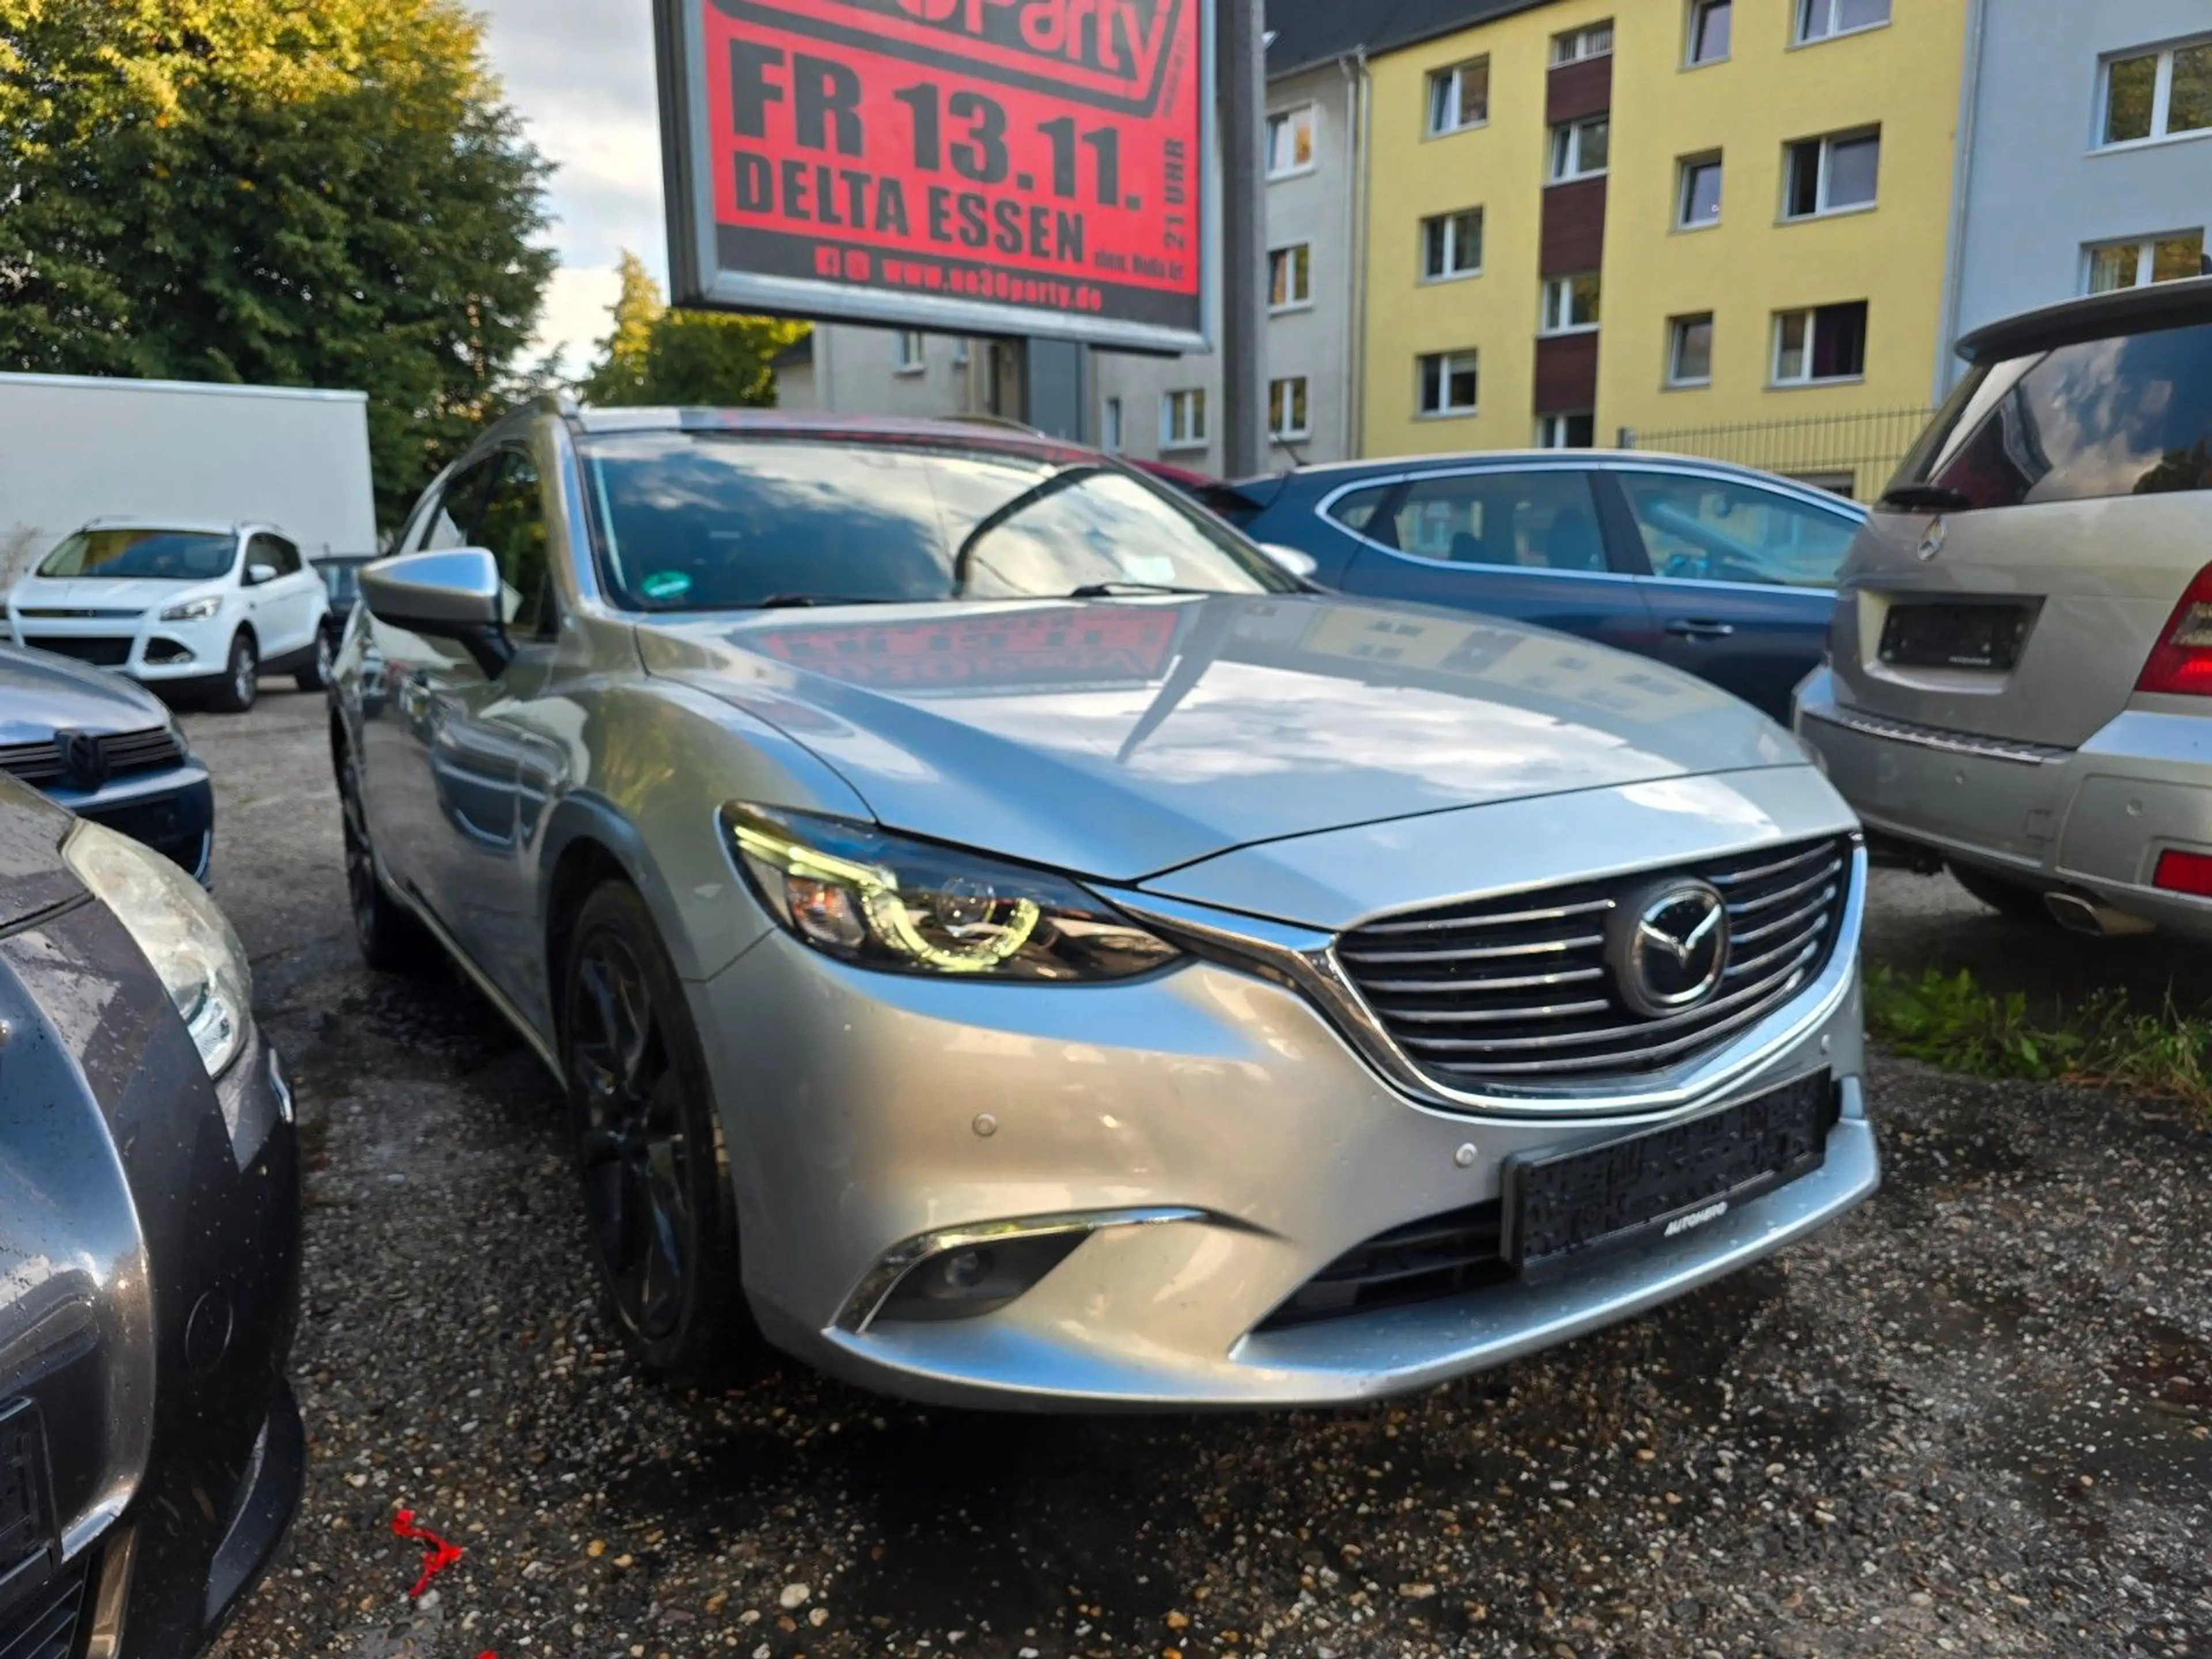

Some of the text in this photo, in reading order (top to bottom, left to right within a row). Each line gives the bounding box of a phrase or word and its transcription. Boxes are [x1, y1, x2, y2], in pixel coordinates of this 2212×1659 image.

[729, 37, 1141, 211] FR 13.11.
[733, 150, 1084, 263] DELTA ESSEN
[1164, 138, 1184, 205] UHR
[1164, 214, 1184, 251] 21
